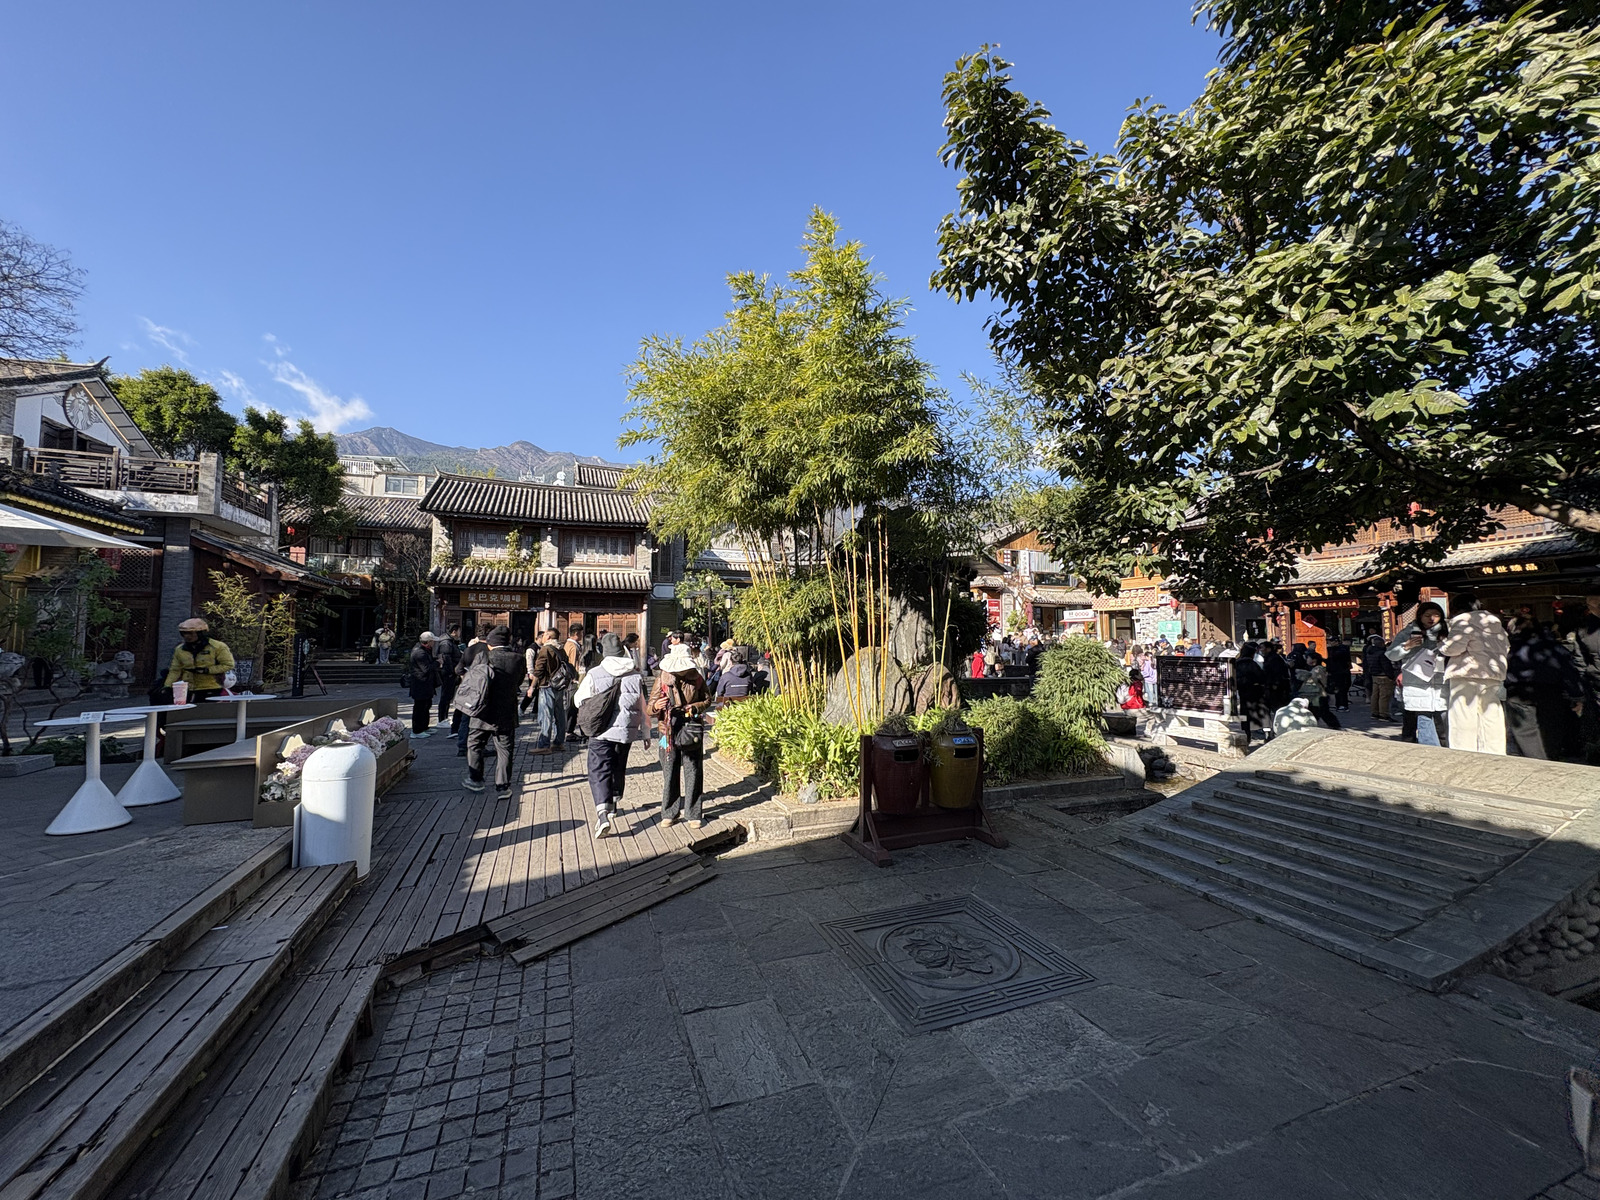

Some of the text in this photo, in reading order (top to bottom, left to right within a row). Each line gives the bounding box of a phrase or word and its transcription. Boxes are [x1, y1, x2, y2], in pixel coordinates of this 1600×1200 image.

[468, 593, 521, 602] 星巴克咖啡
